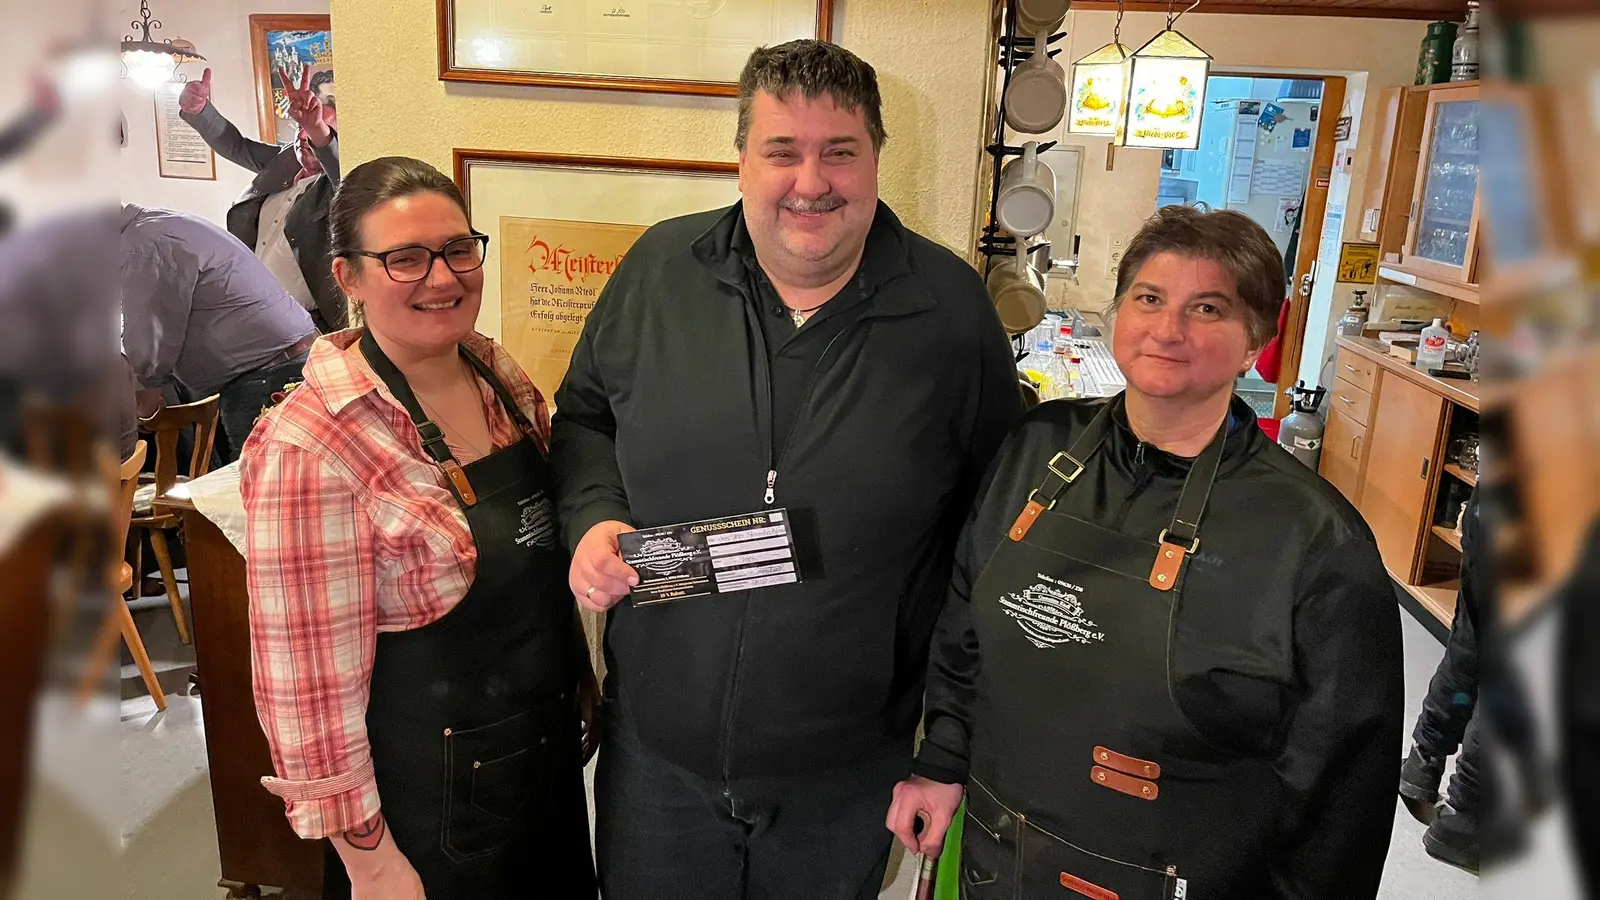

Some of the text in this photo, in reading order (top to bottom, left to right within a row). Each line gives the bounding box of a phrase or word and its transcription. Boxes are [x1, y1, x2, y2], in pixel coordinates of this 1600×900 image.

[530, 282, 598, 297] Herr Johann Riedl
[530, 309, 583, 324] Erfolg abgelegt
[690, 516, 767, 534] GENUSSSCHEIN NR:
[1059, 619, 1092, 639] Plößberg
